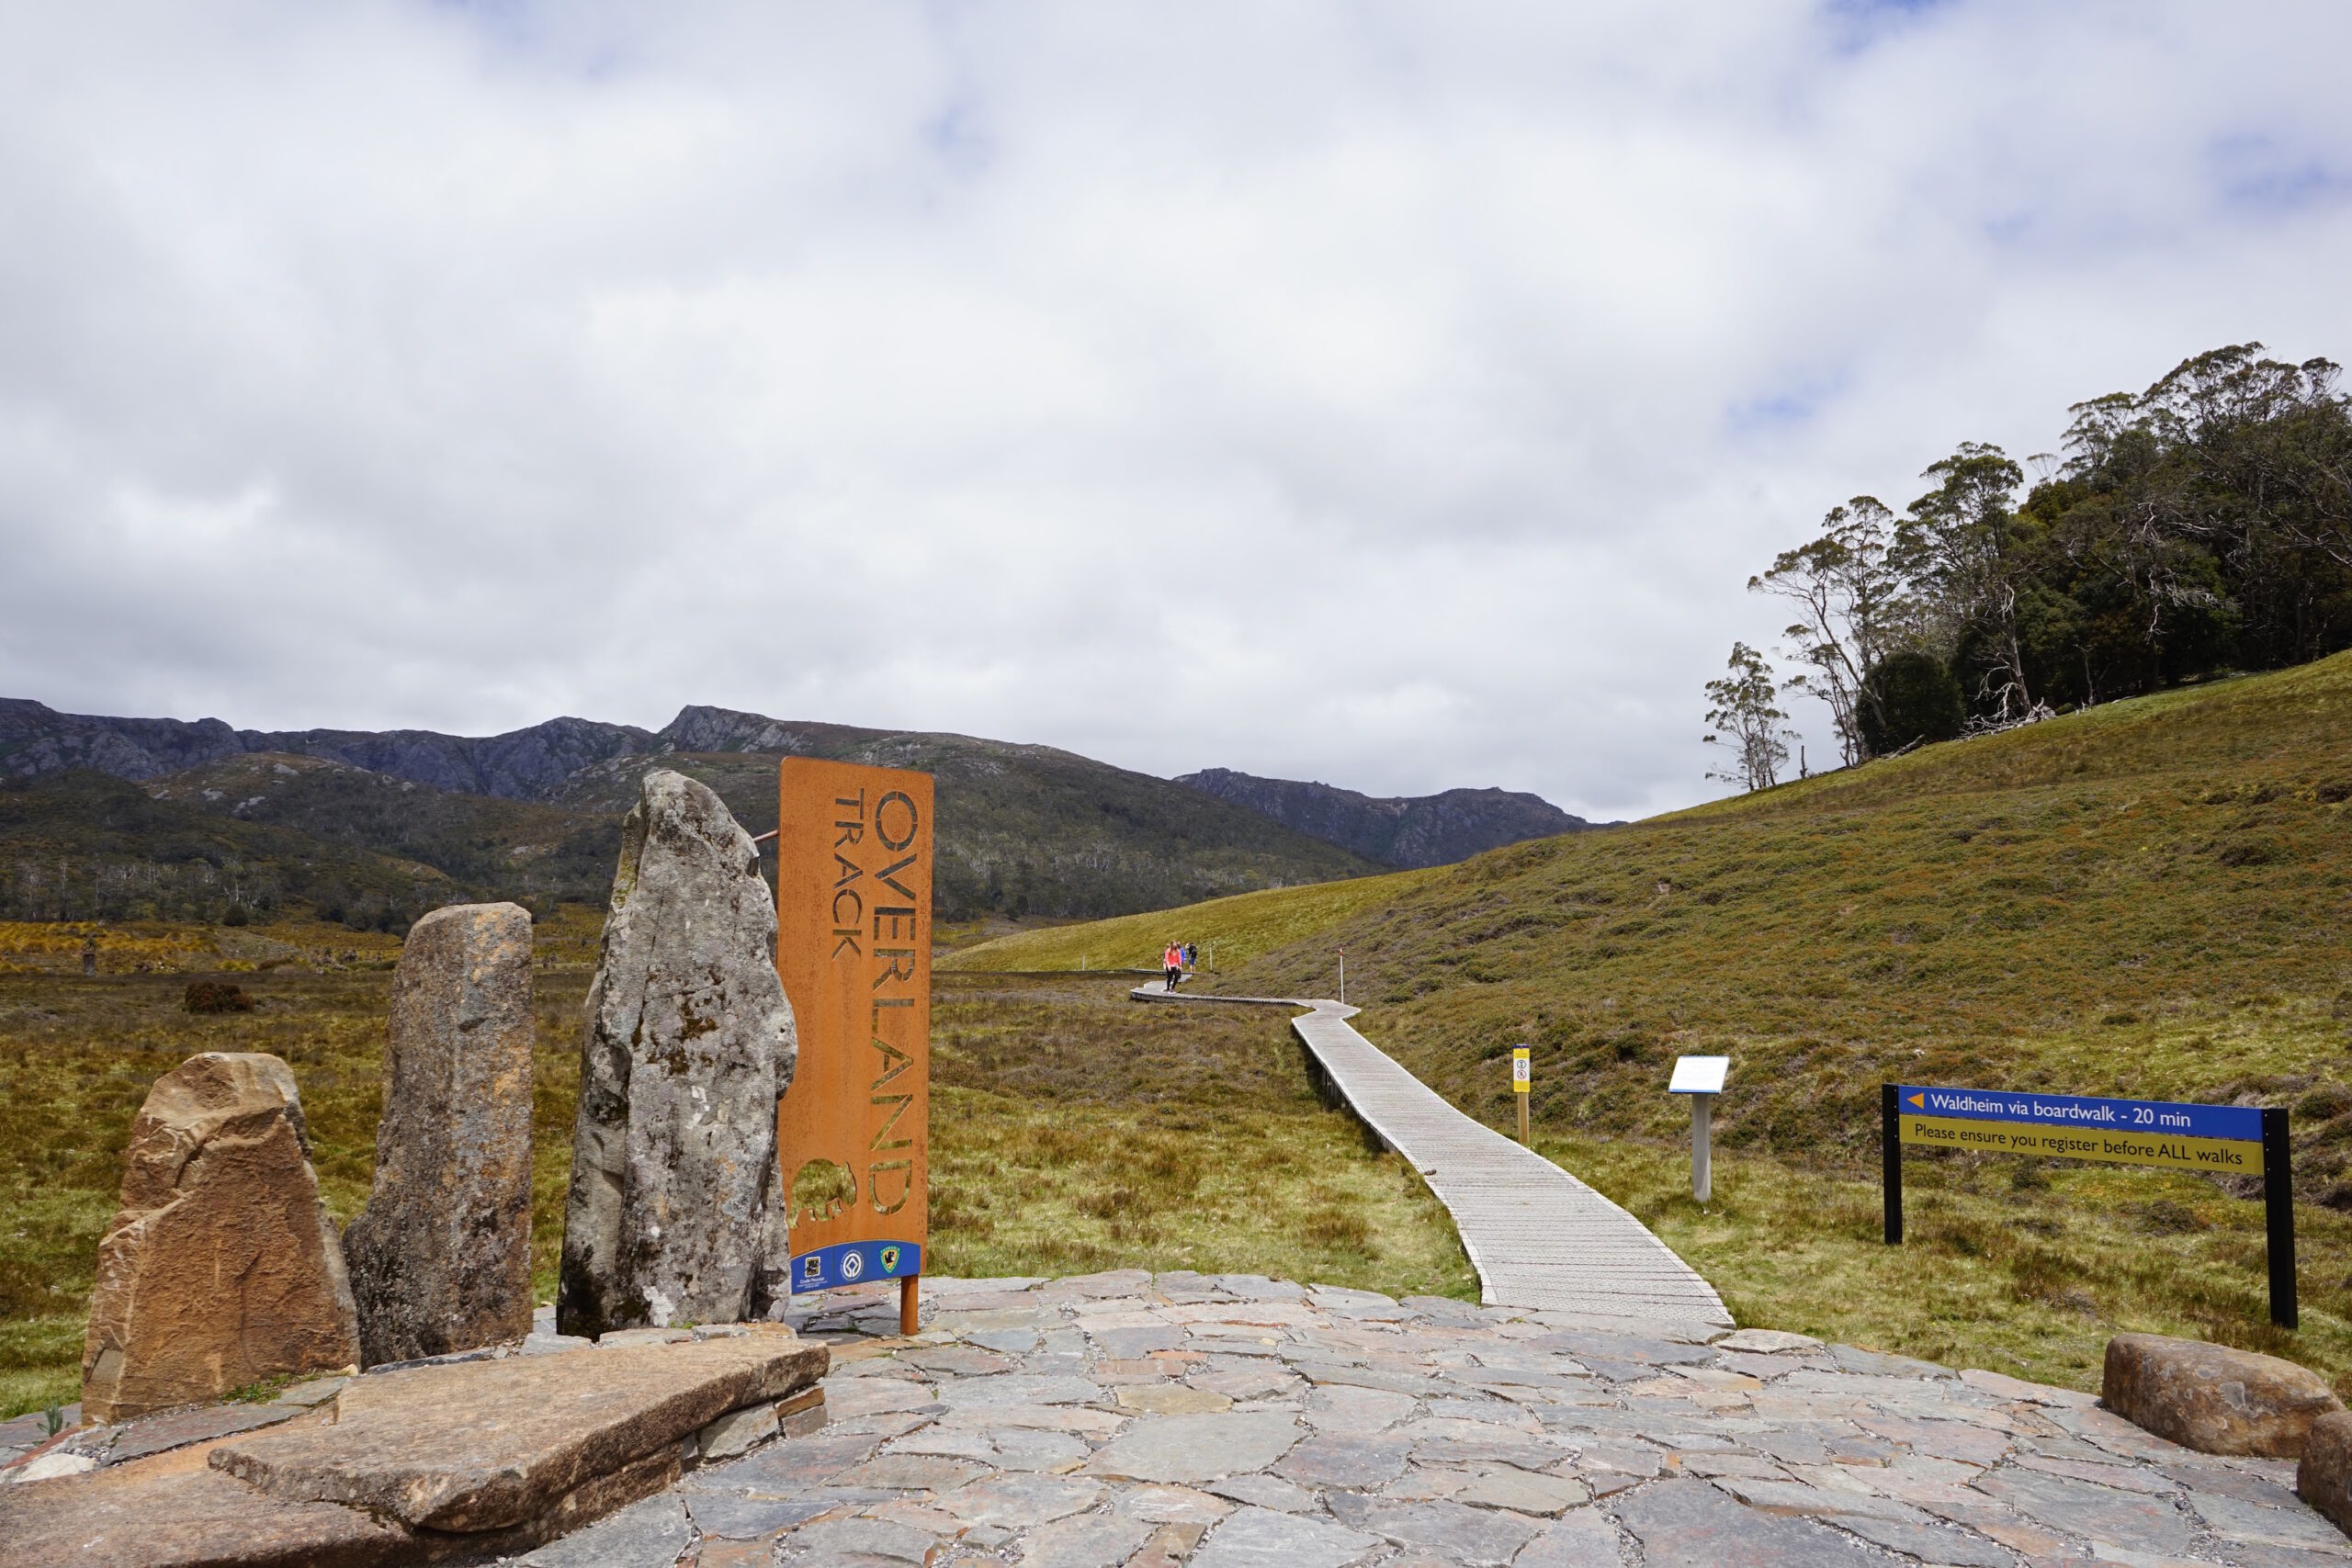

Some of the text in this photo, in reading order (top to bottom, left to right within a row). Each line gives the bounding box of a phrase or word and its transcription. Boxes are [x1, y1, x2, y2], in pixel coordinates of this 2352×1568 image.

[831, 787, 865, 962] TRACK
[869, 791, 918, 1215] OVERLAND
[1916, 1123, 2243, 1165] Please ensure you register before ALL walks
[1930, 1094, 2003, 1113] Waldheim
[2008, 1100, 2029, 1115] via
[2033, 1101, 2116, 1122] boardwalk
[2132, 1107, 2154, 1124] 20
[2160, 1112, 2191, 1127] min
